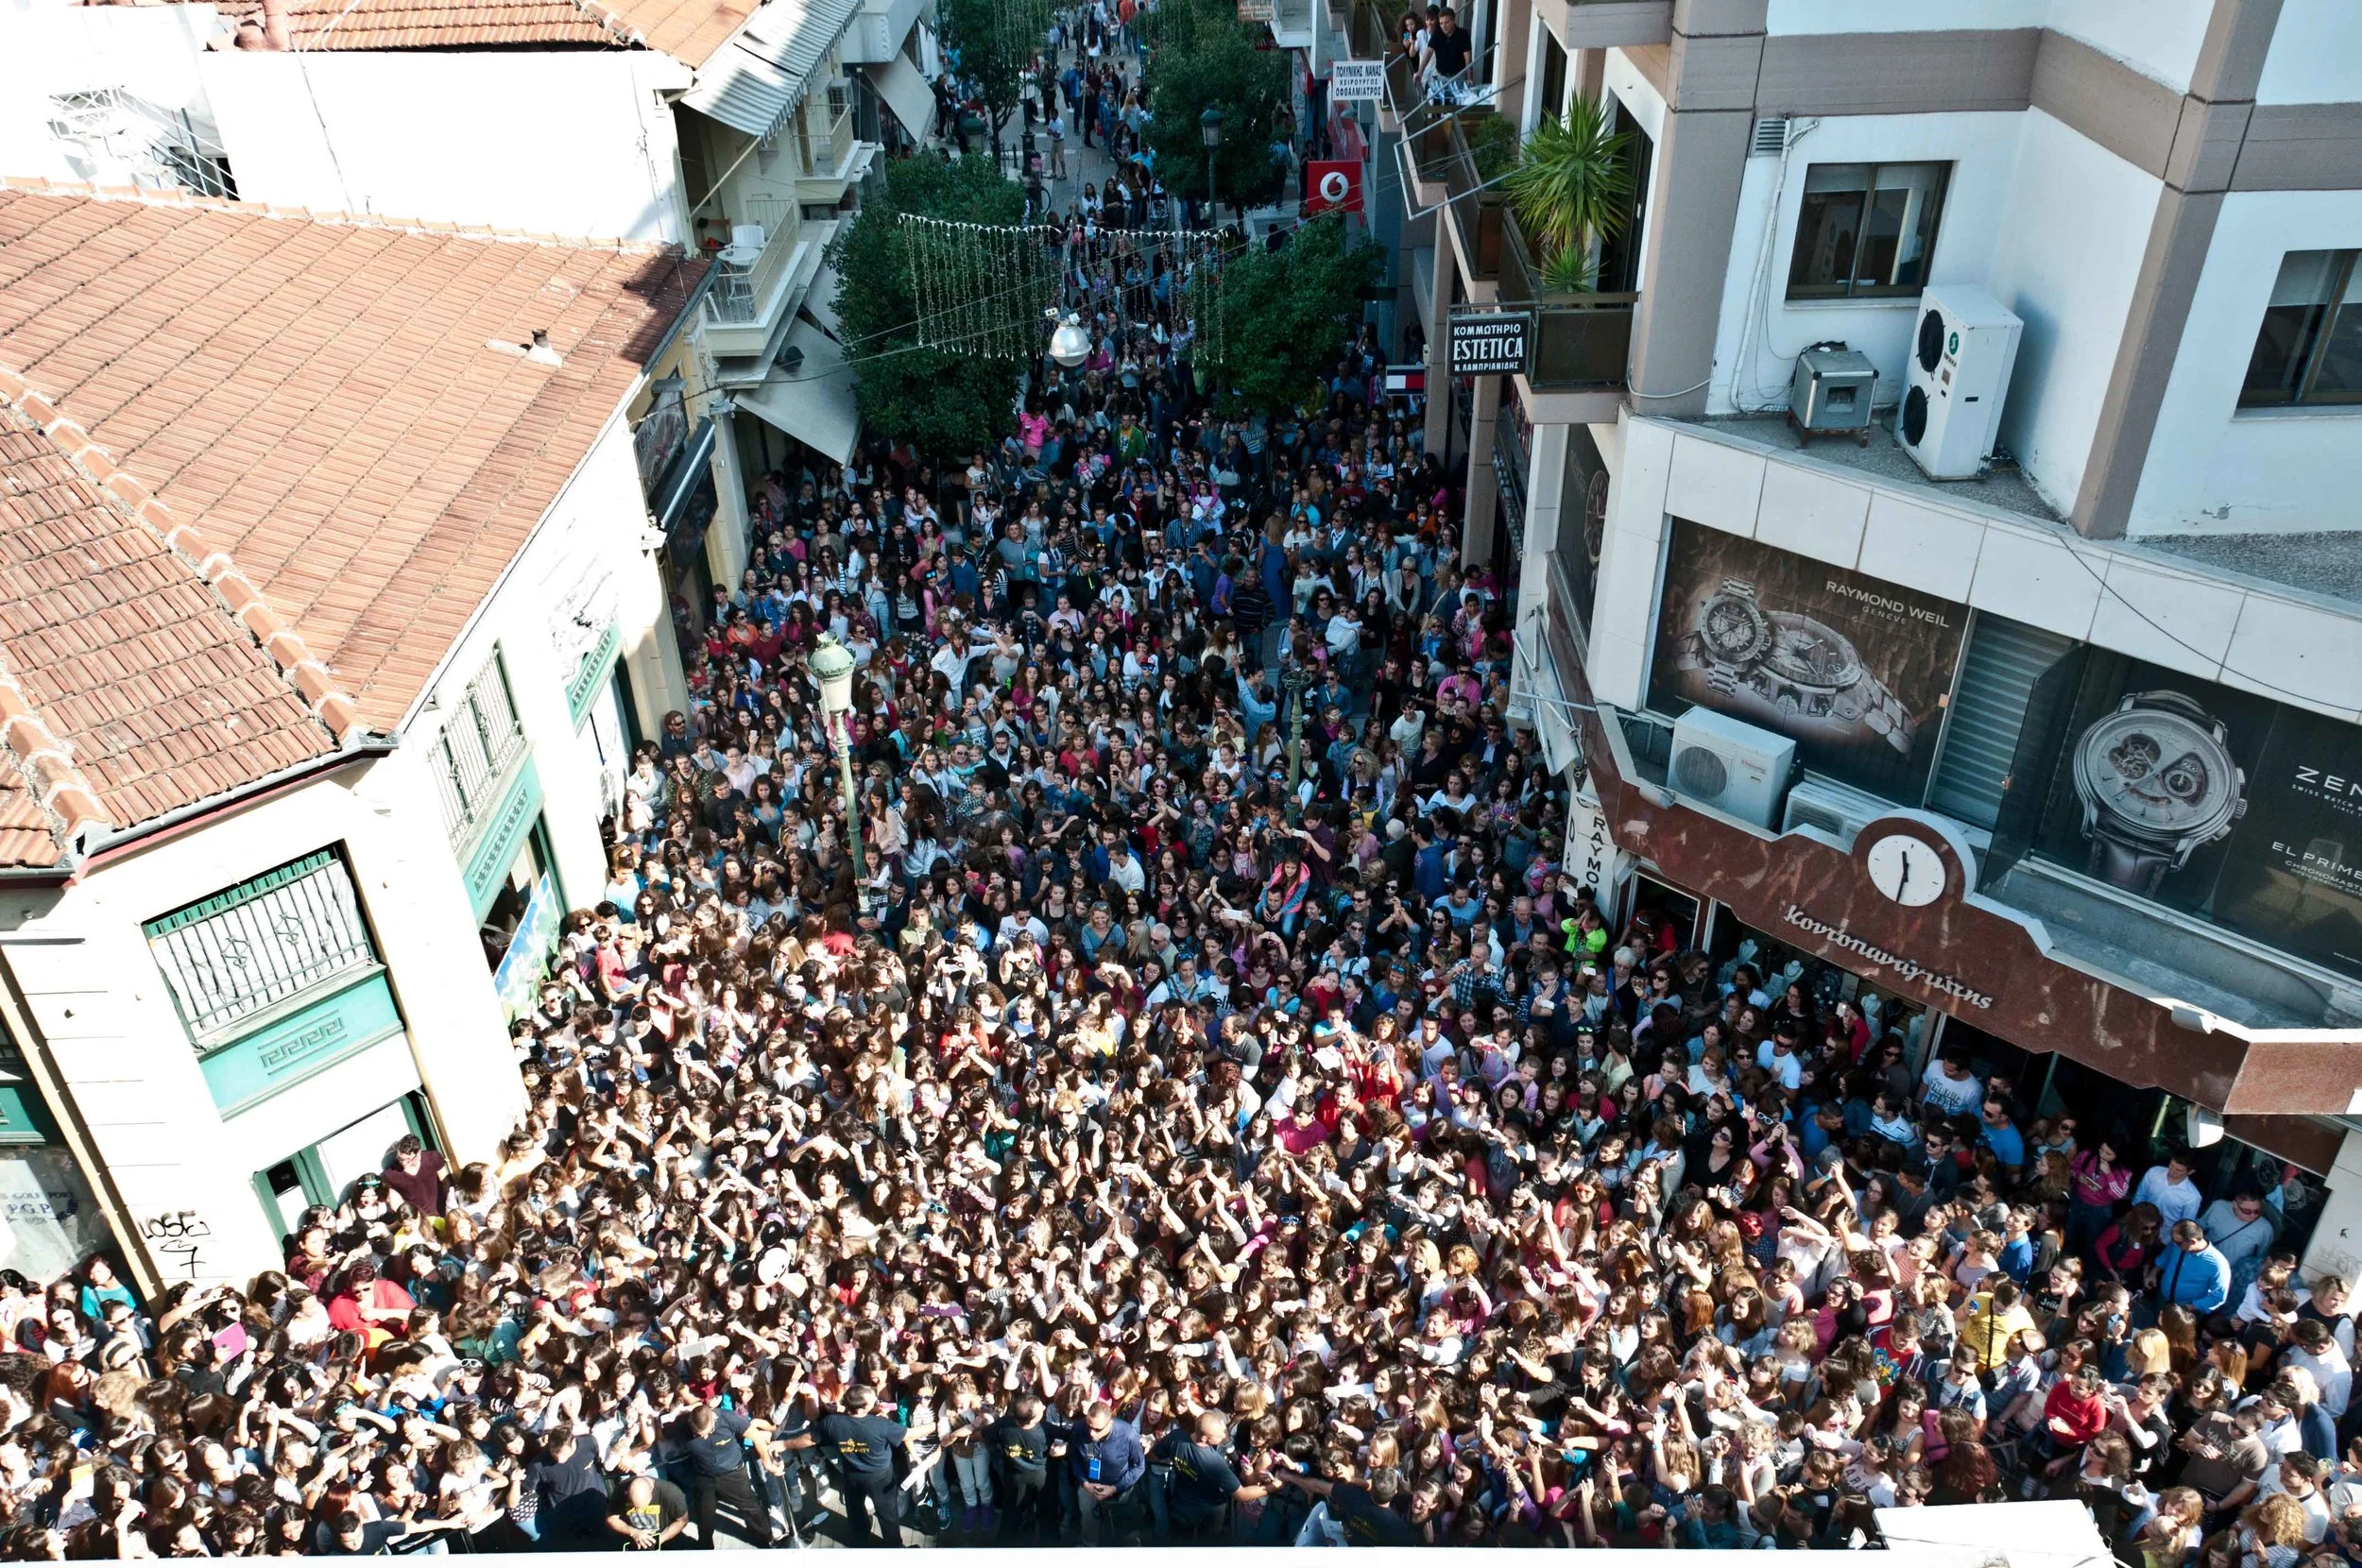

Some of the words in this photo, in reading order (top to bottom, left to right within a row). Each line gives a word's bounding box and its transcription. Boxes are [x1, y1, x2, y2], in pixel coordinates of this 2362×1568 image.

[1454, 323, 1521, 336] ΚΟΜΜΩΤΗΡΙΟ
[1453, 336, 1523, 361] ESTETICA
[1826, 580, 1905, 613] RAYMOND
[1909, 605, 1949, 628] WEIL
[2324, 794, 2353, 808] WATCH
[2272, 841, 2297, 857] EL
